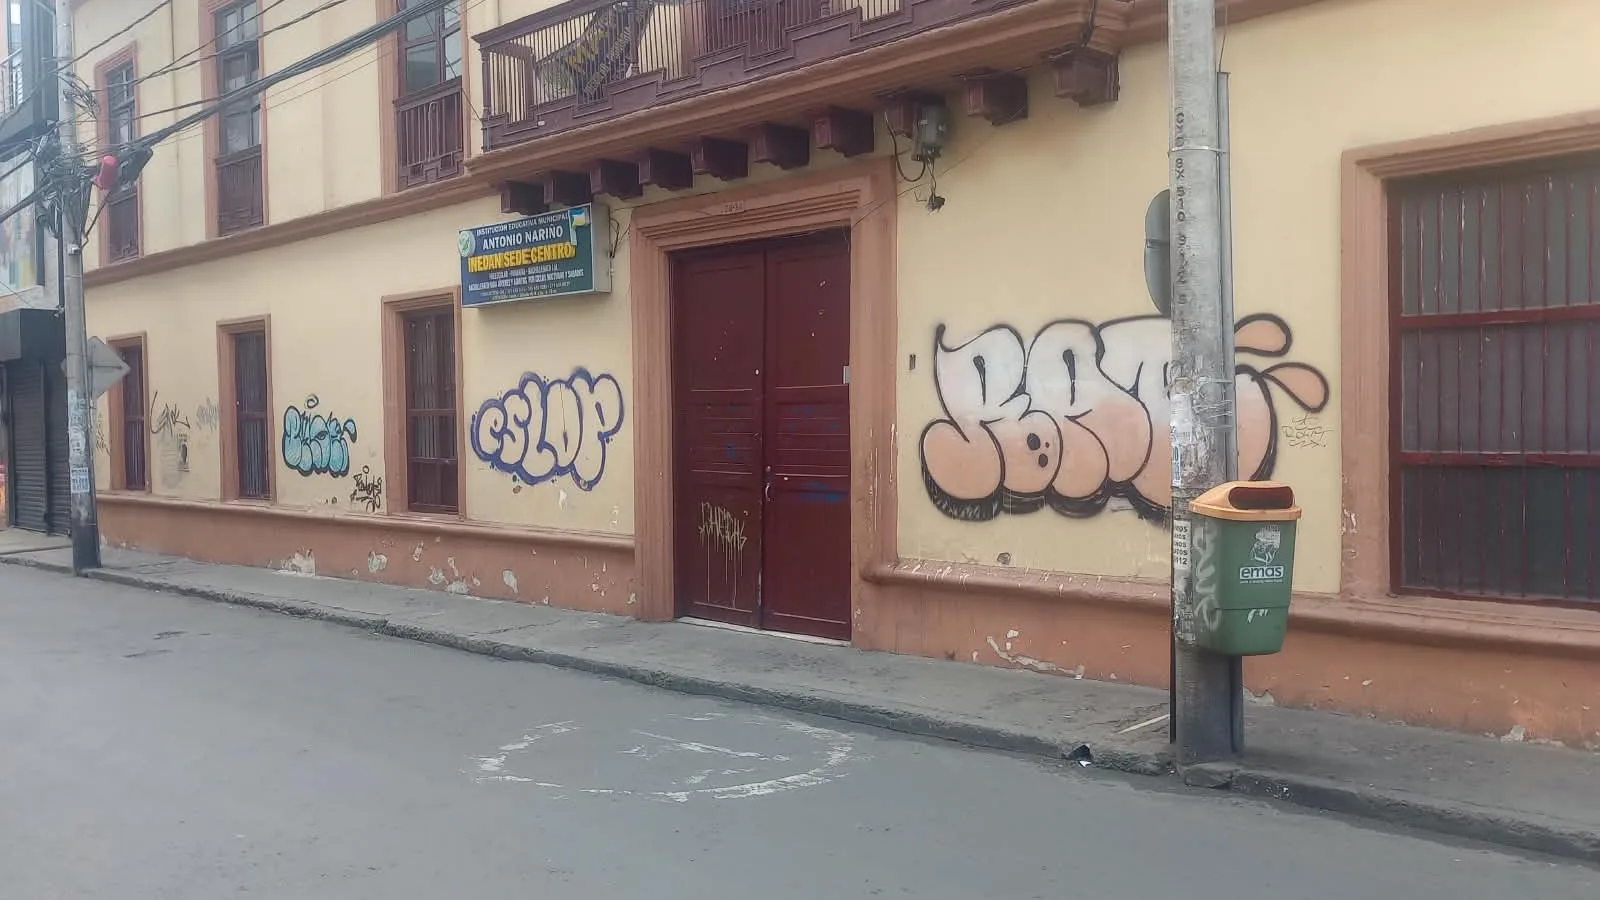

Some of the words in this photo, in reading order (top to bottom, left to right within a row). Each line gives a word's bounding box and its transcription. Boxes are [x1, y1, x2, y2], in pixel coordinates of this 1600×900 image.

[508, 219, 537, 232] EDUCATIVA
[538, 214, 569, 226] MUNICIPAL
[482, 234, 522, 250] ANTONIO
[525, 223, 564, 244] NARIÑO
[468, 252, 504, 273] INEDAN
[504, 249, 529, 268] SEDE
[530, 242, 573, 263] CENTRO
[1241, 567, 1282, 578] emas
